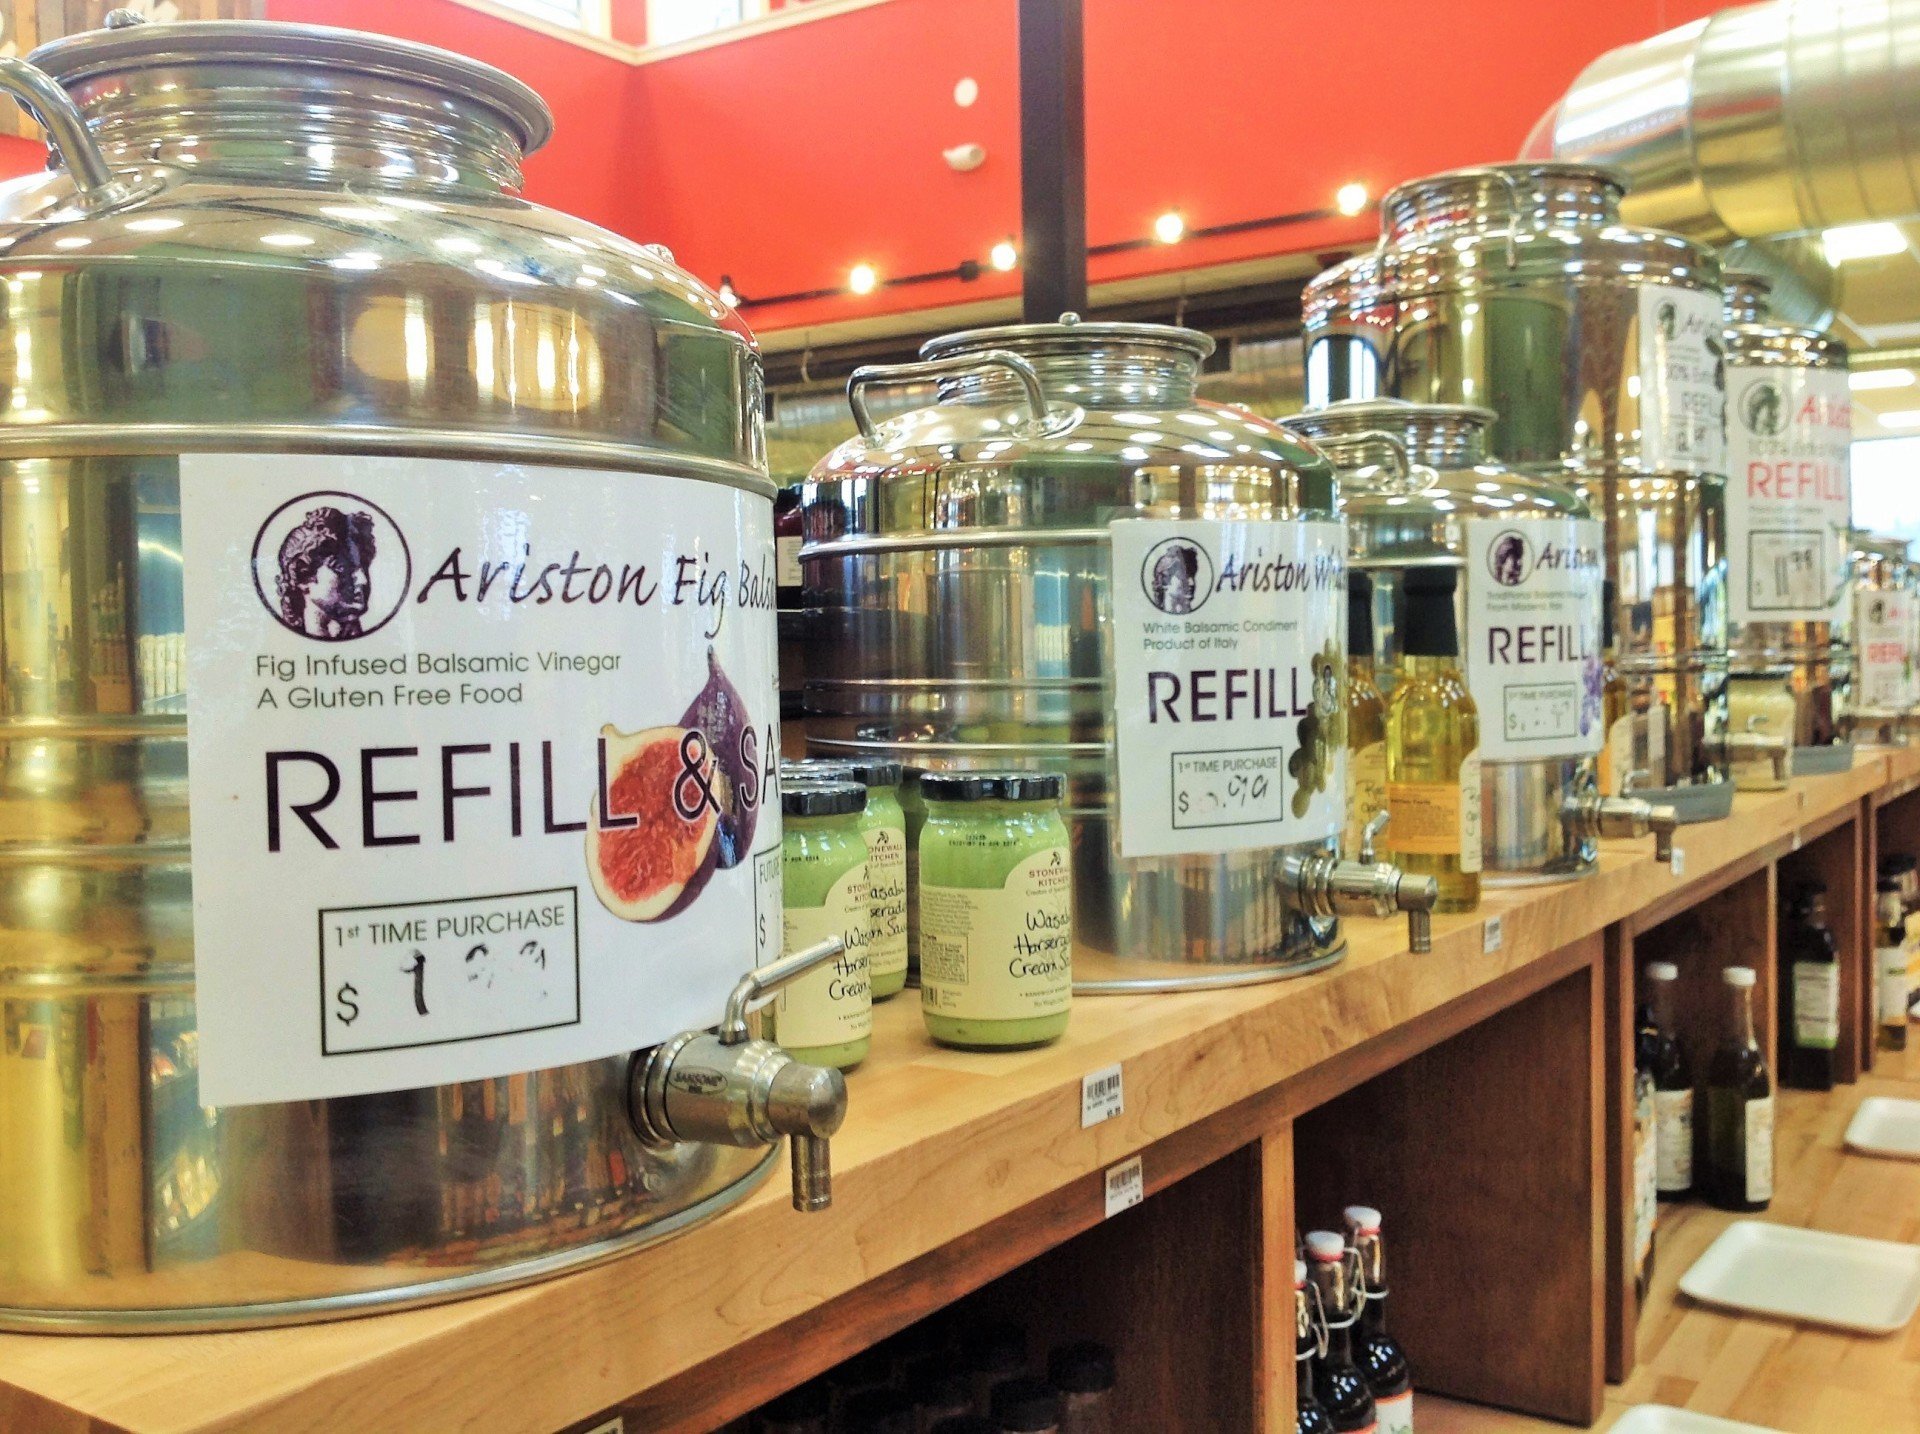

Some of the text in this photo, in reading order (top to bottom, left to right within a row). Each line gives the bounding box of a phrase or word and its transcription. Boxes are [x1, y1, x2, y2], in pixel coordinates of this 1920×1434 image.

[1747, 461, 1845, 500] REFILL
[1216, 547, 1310, 592] Ariston
[416, 542, 659, 606] Ariston
[672, 552, 727, 640] Fig
[1143, 619, 1298, 634] White Balsamic Condiment
[1143, 637, 1239, 651] Product of Italy
[1488, 625, 1589, 664] REFILL
[256, 651, 621, 681] Fig Infused Balsamic Vinegar
[257, 682, 523, 709] A Gluten Free Food
[1147, 666, 1308, 723] REFILL
[1193, 760, 1219, 773] TIME
[1223, 756, 1278, 771] PURCHASE
[266, 722, 781, 853] REFILL & SA
[1178, 790, 1190, 814] $
[870, 853, 900, 862] ITCHEN
[334, 904, 566, 947] 1st TIME PURCHASE
[759, 912, 767, 949] $
[1008, 957, 1058, 978] Cream
[336, 982, 360, 1027] $
